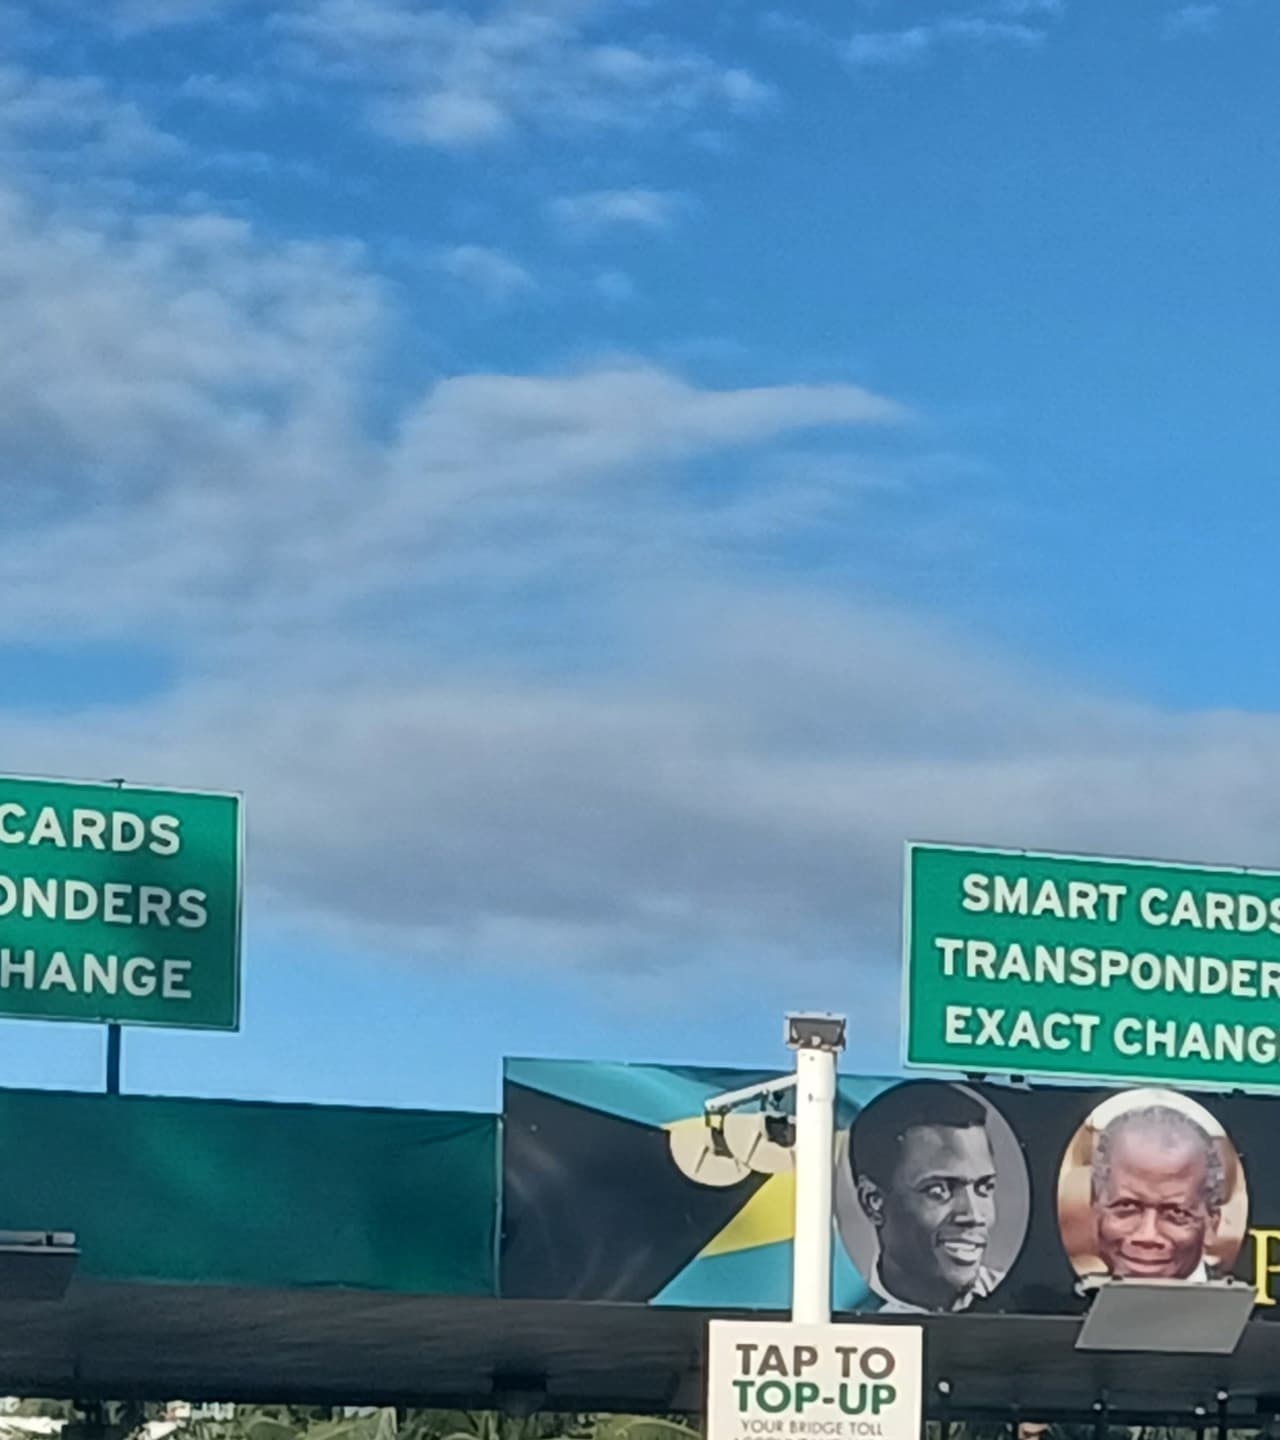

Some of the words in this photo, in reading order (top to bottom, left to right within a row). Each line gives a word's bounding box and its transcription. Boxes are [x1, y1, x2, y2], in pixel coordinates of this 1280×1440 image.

[0, 803, 180, 855] CARDS
[961, 873, 1127, 922] SMART
[944, 1005, 1099, 1052] EXACT
[736, 1343, 818, 1377] TAP
[835, 1346, 895, 1380] TO
[732, 1380, 897, 1415] TOP-UP
[741, 1420, 783, 1434] YOUR
[790, 1421, 842, 1435] BRIDGE
[849, 1422, 882, 1435] TOLL
